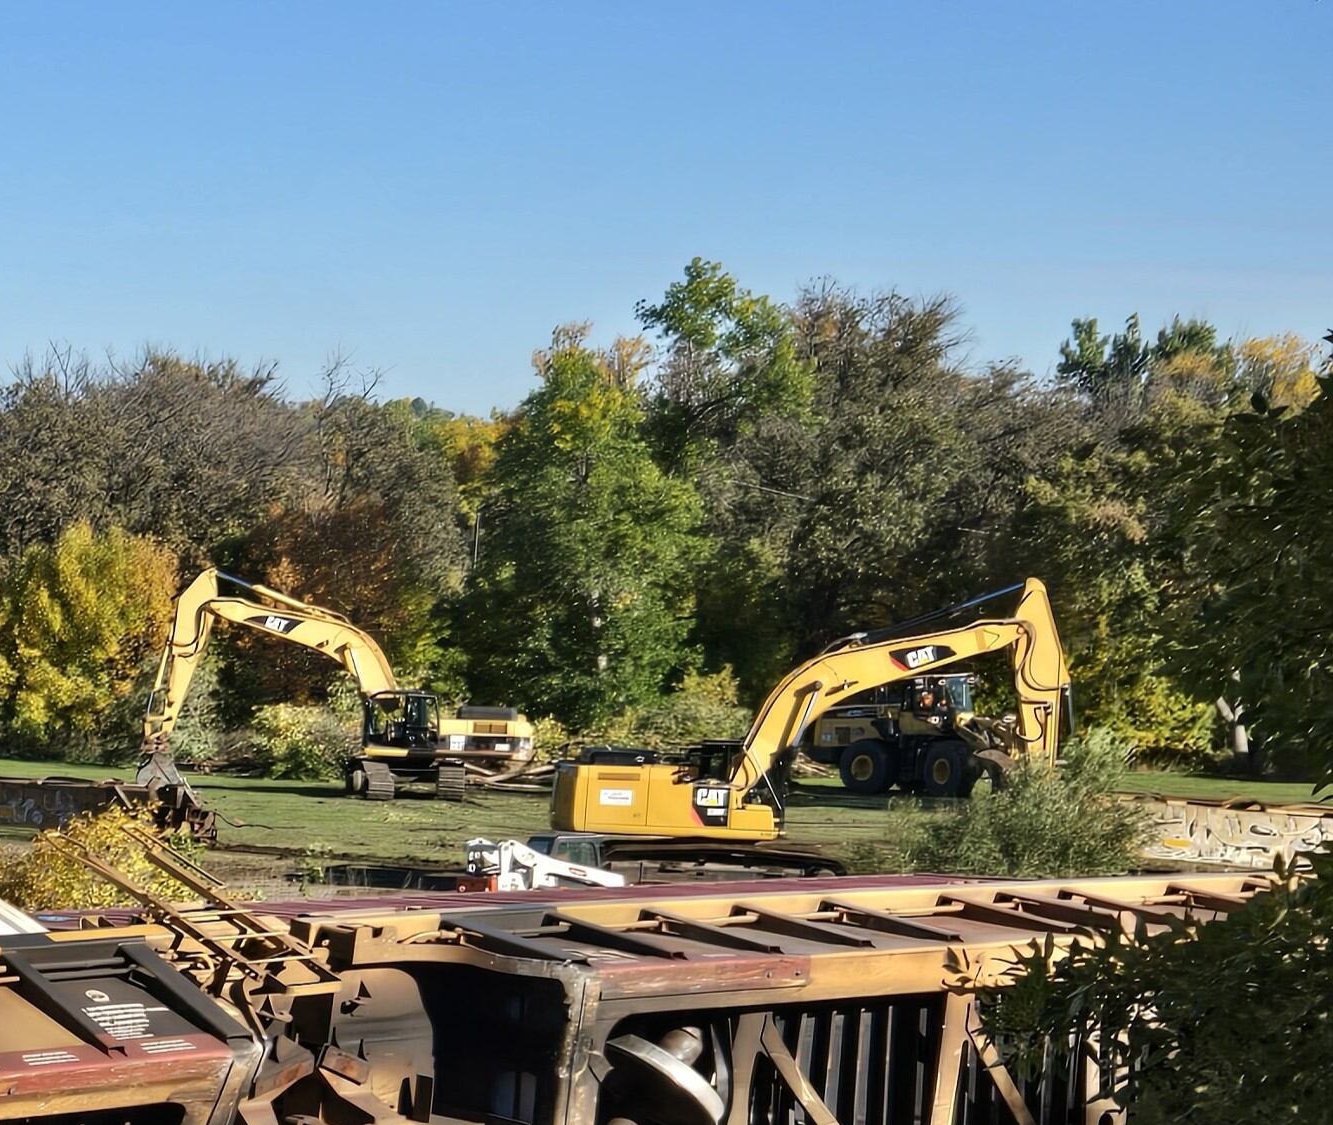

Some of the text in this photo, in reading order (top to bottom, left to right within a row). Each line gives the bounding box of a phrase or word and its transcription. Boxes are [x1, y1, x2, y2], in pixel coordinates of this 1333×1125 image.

[264, 615, 290, 633] CAT
[906, 645, 935, 669] CAT
[697, 788, 727, 806] CAT
